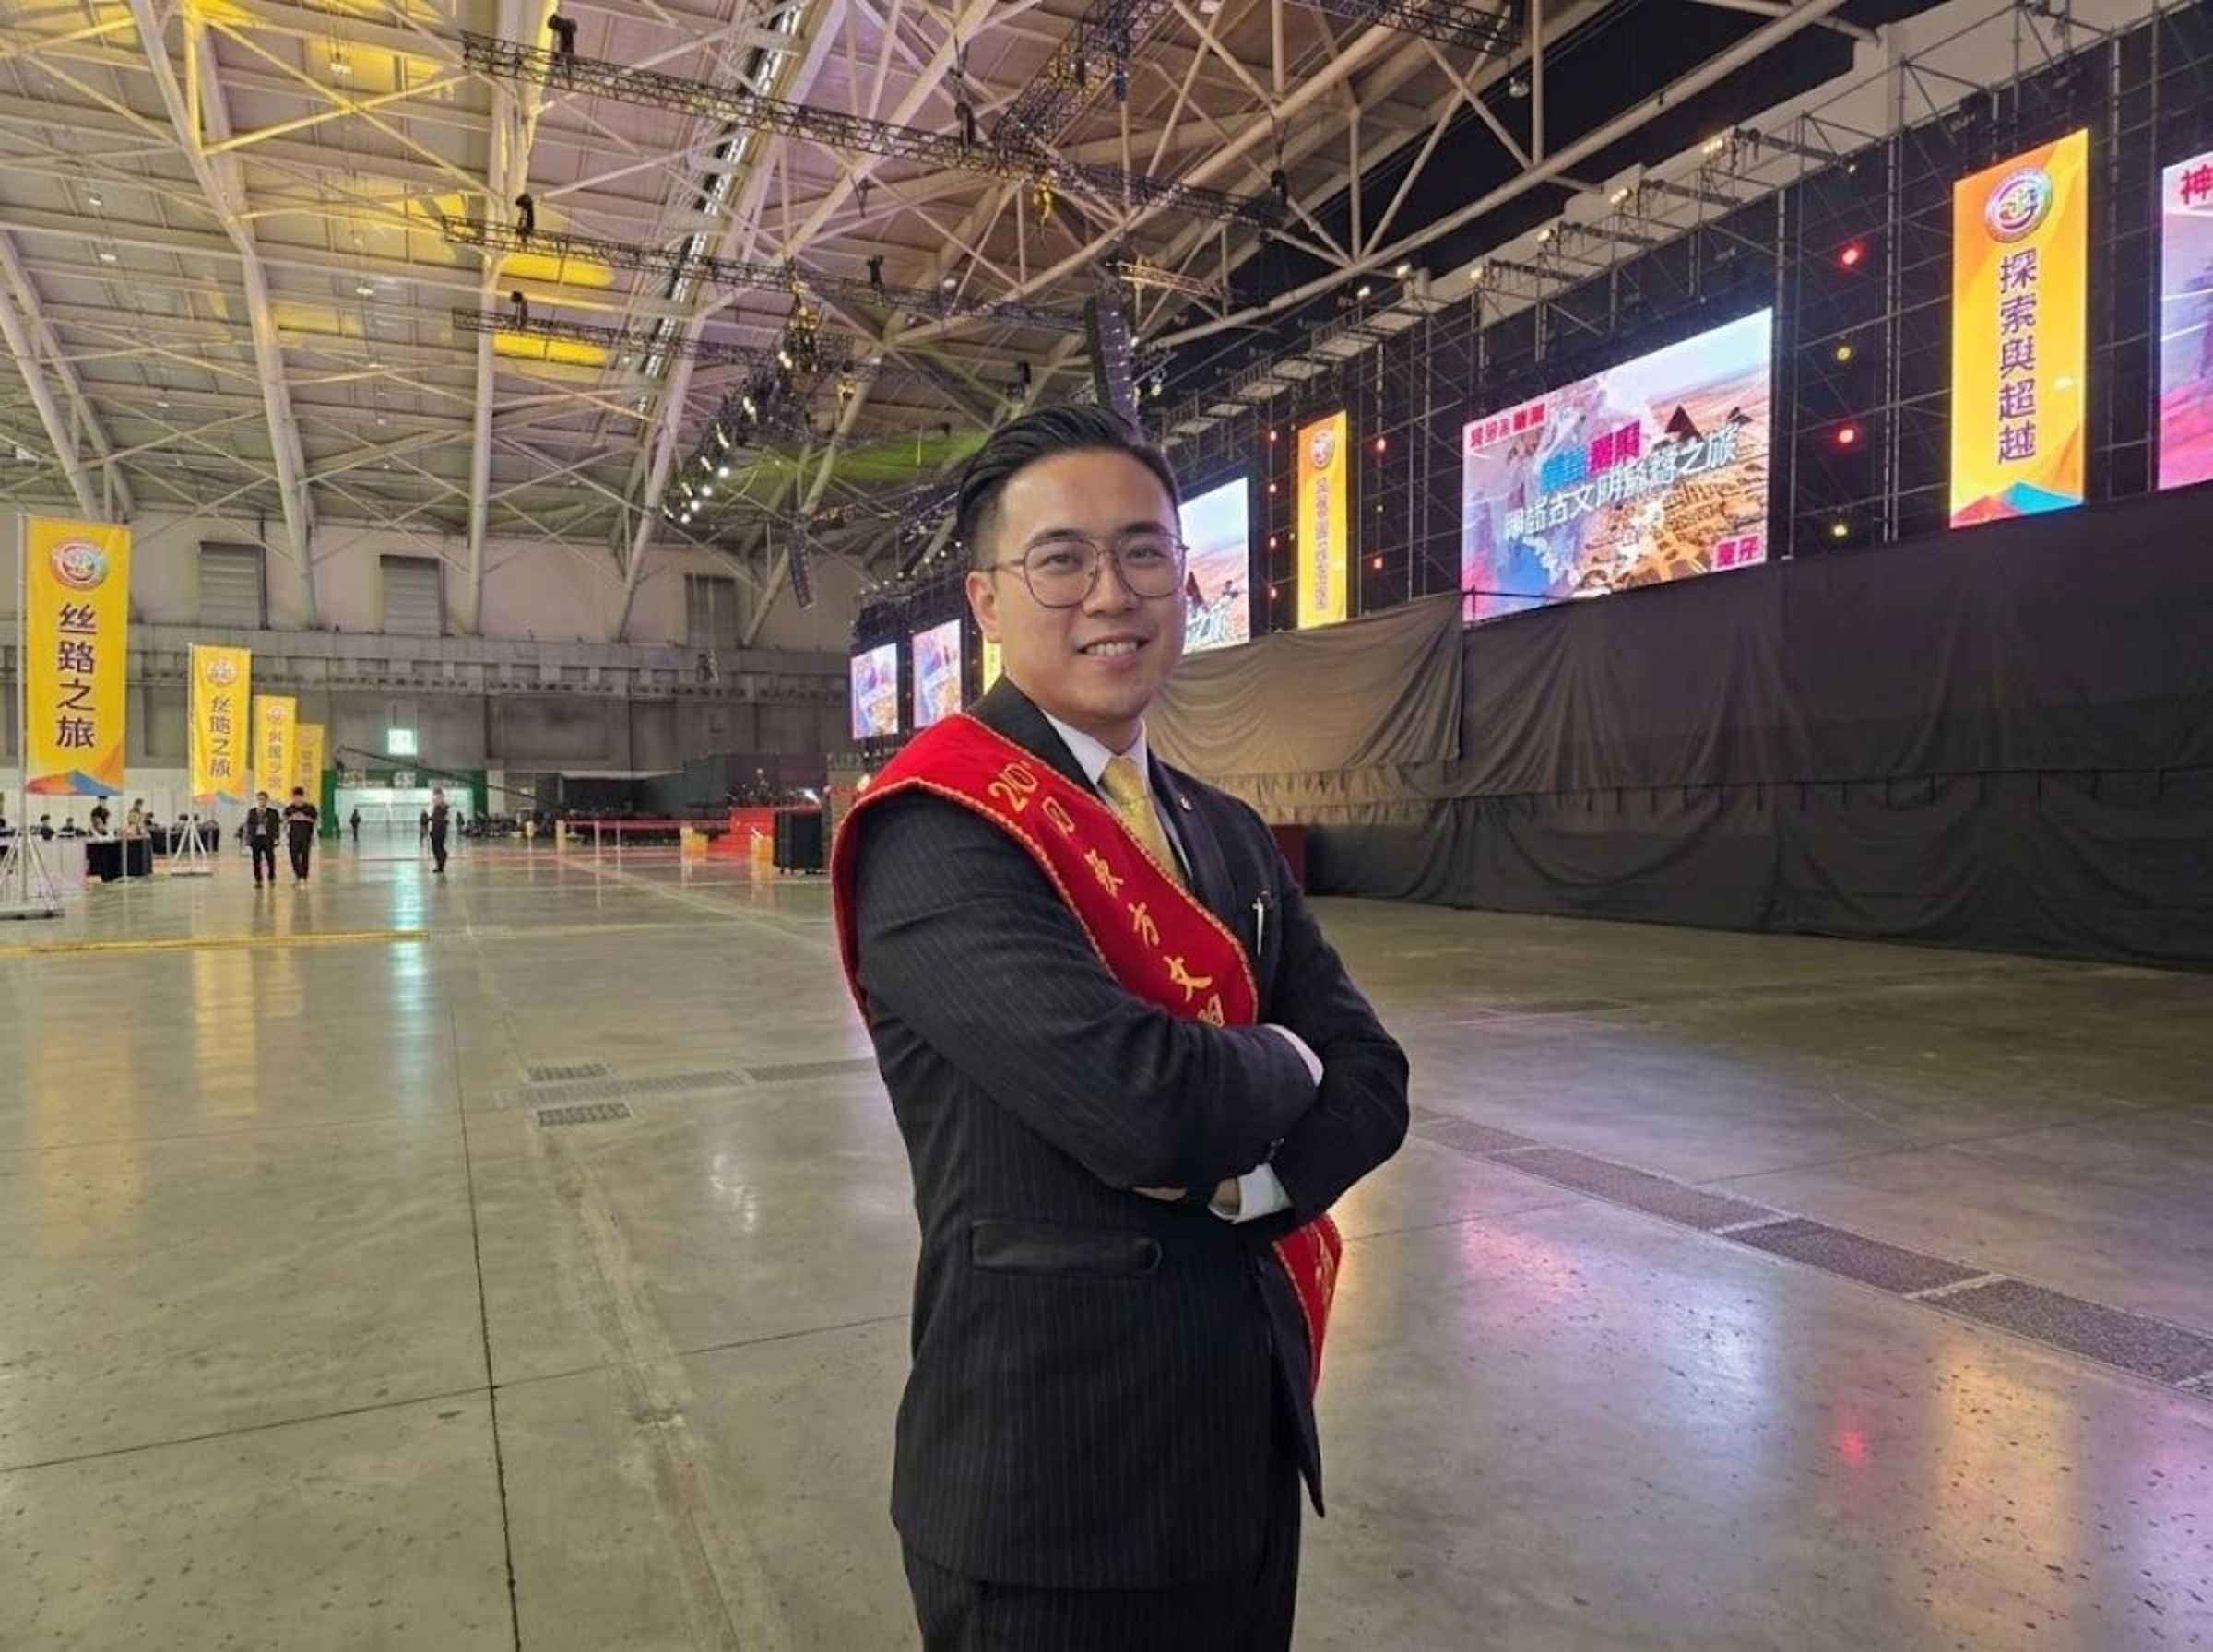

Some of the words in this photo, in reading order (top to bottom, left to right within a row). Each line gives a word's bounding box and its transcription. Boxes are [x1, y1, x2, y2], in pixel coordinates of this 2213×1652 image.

[1998, 248, 2037, 464] 探索與超越
[56, 603, 98, 749] 丝路之旅
